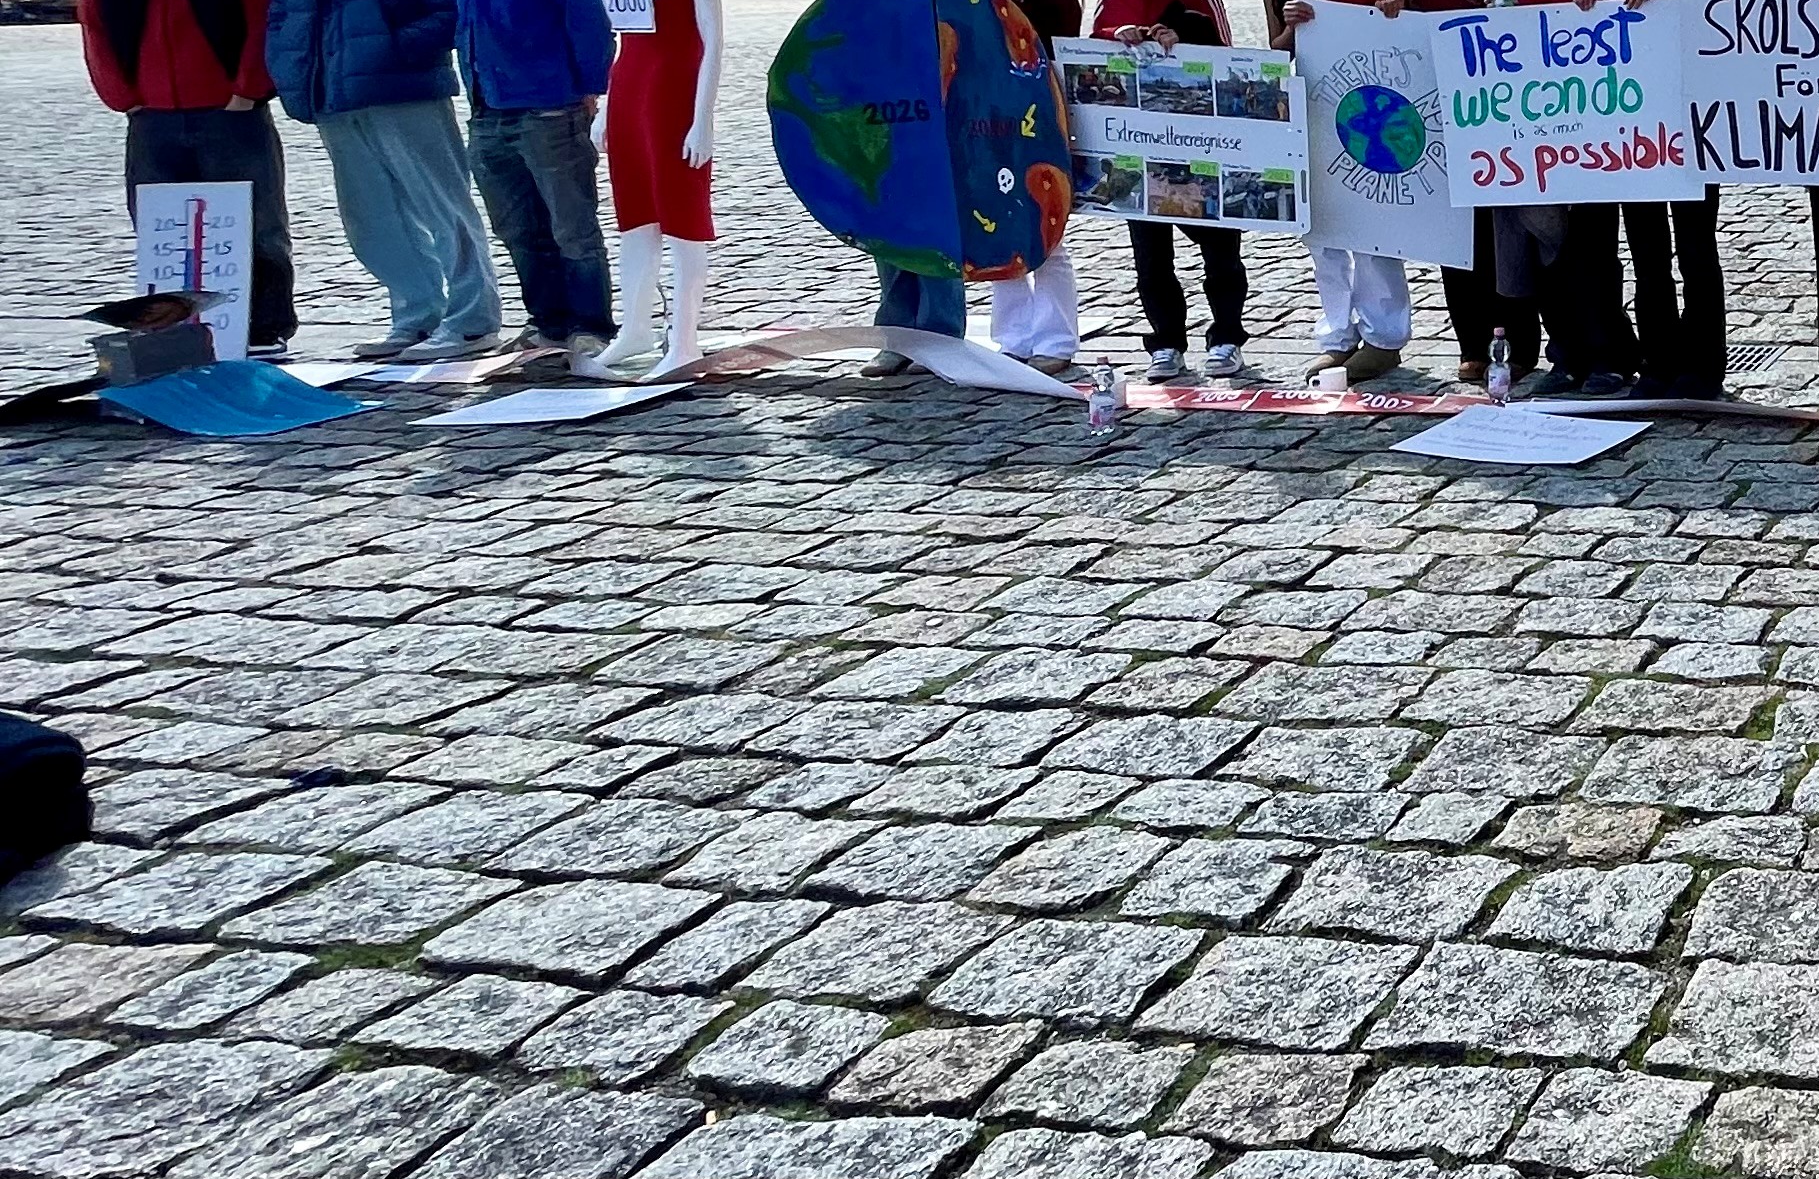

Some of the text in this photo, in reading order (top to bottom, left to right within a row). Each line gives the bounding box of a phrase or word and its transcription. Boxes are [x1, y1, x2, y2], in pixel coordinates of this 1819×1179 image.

[1438, 5, 1647, 78] The least
[1309, 46, 1422, 108] THERE'S
[1452, 65, 1645, 128] we can do
[862, 98, 931, 125] 2026
[1327, 150, 1434, 205] PLANET
[1470, 146, 1525, 187] as
[1356, 392, 1414, 410] 2007
